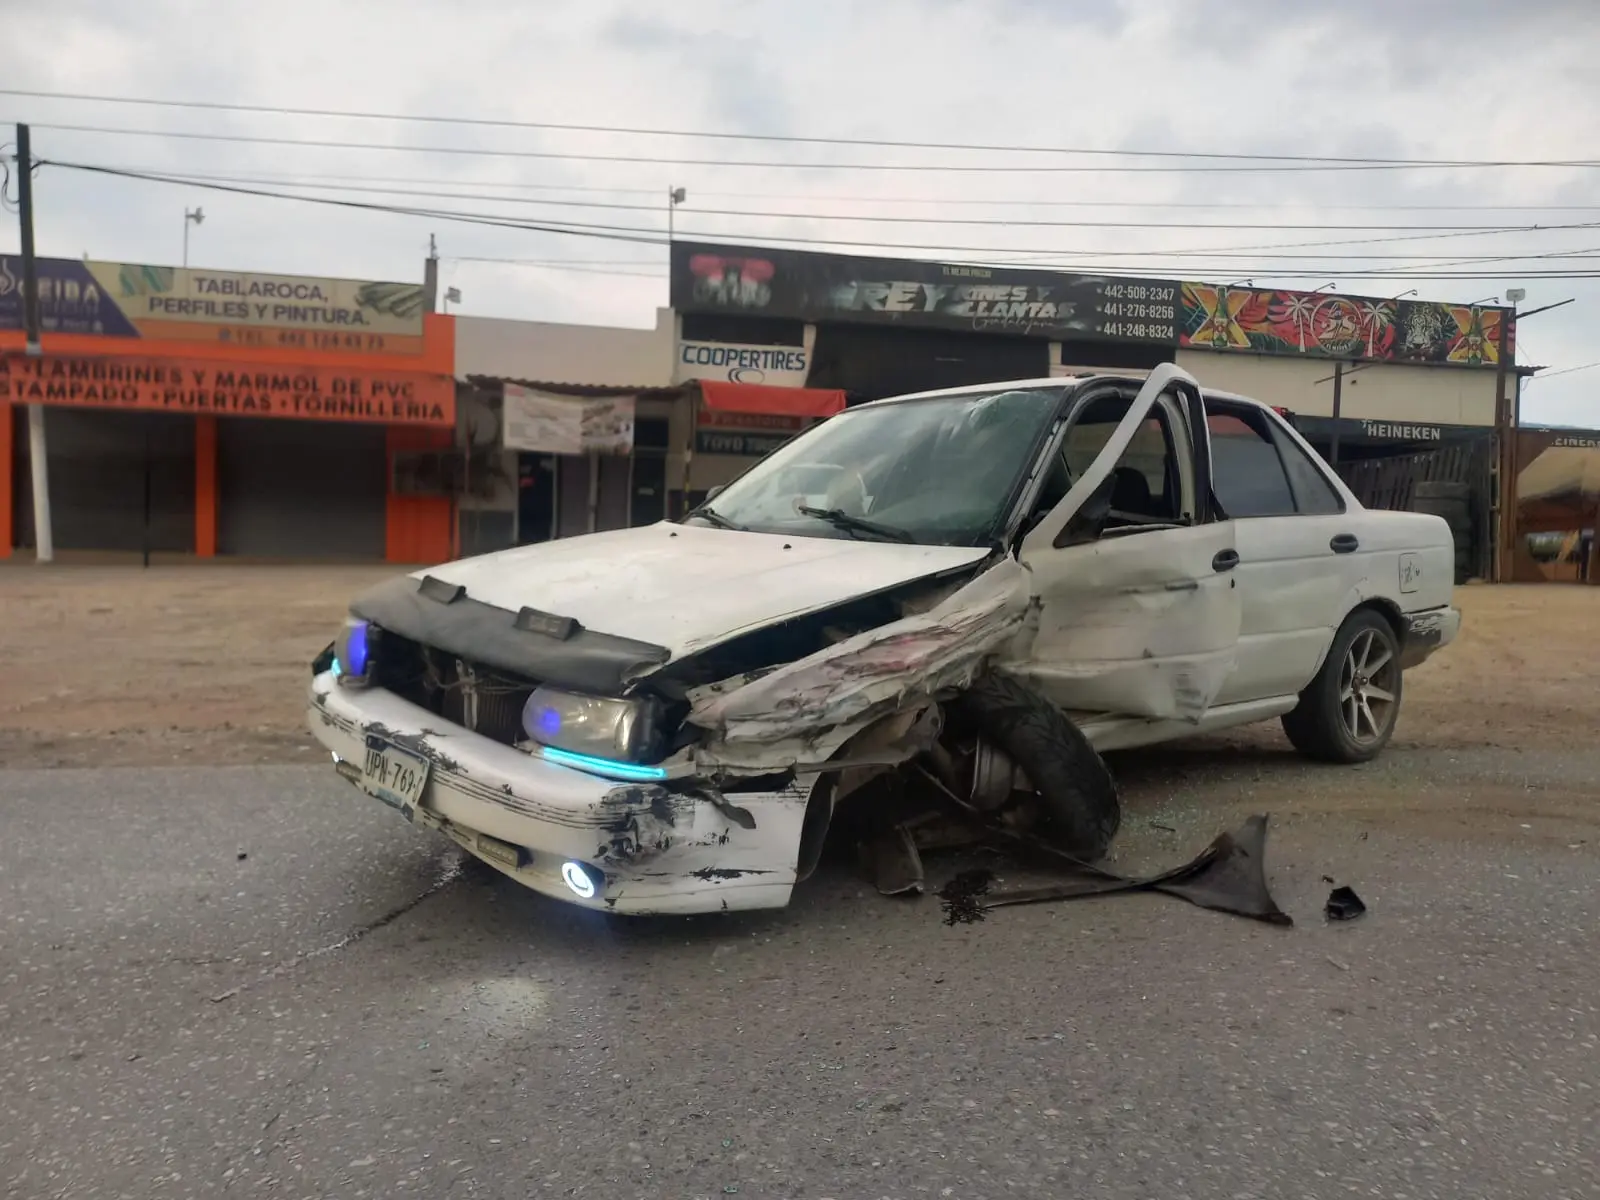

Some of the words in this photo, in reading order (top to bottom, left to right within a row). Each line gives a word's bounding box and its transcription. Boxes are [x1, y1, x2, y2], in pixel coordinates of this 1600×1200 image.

[194, 277, 328, 302] TABLAROCA,
[850, 280, 953, 312] REY
[1104, 284, 1175, 301] 442-508-2347
[150, 297, 249, 319] PERFILES
[254, 303, 268, 319] Y
[273, 303, 370, 326] PINTURA.
[962, 301, 1077, 319] LLANTAS
[1103, 321, 1174, 338] 441-248-8324
[682, 345, 806, 371] COOPERTIRES
[192, 369, 206, 386] Y
[332, 376, 362, 396] DE
[371, 380, 414, 399] PVC
[163, 388, 271, 412] PUERTAS
[1367, 424, 1441, 441] HEINEKEN
